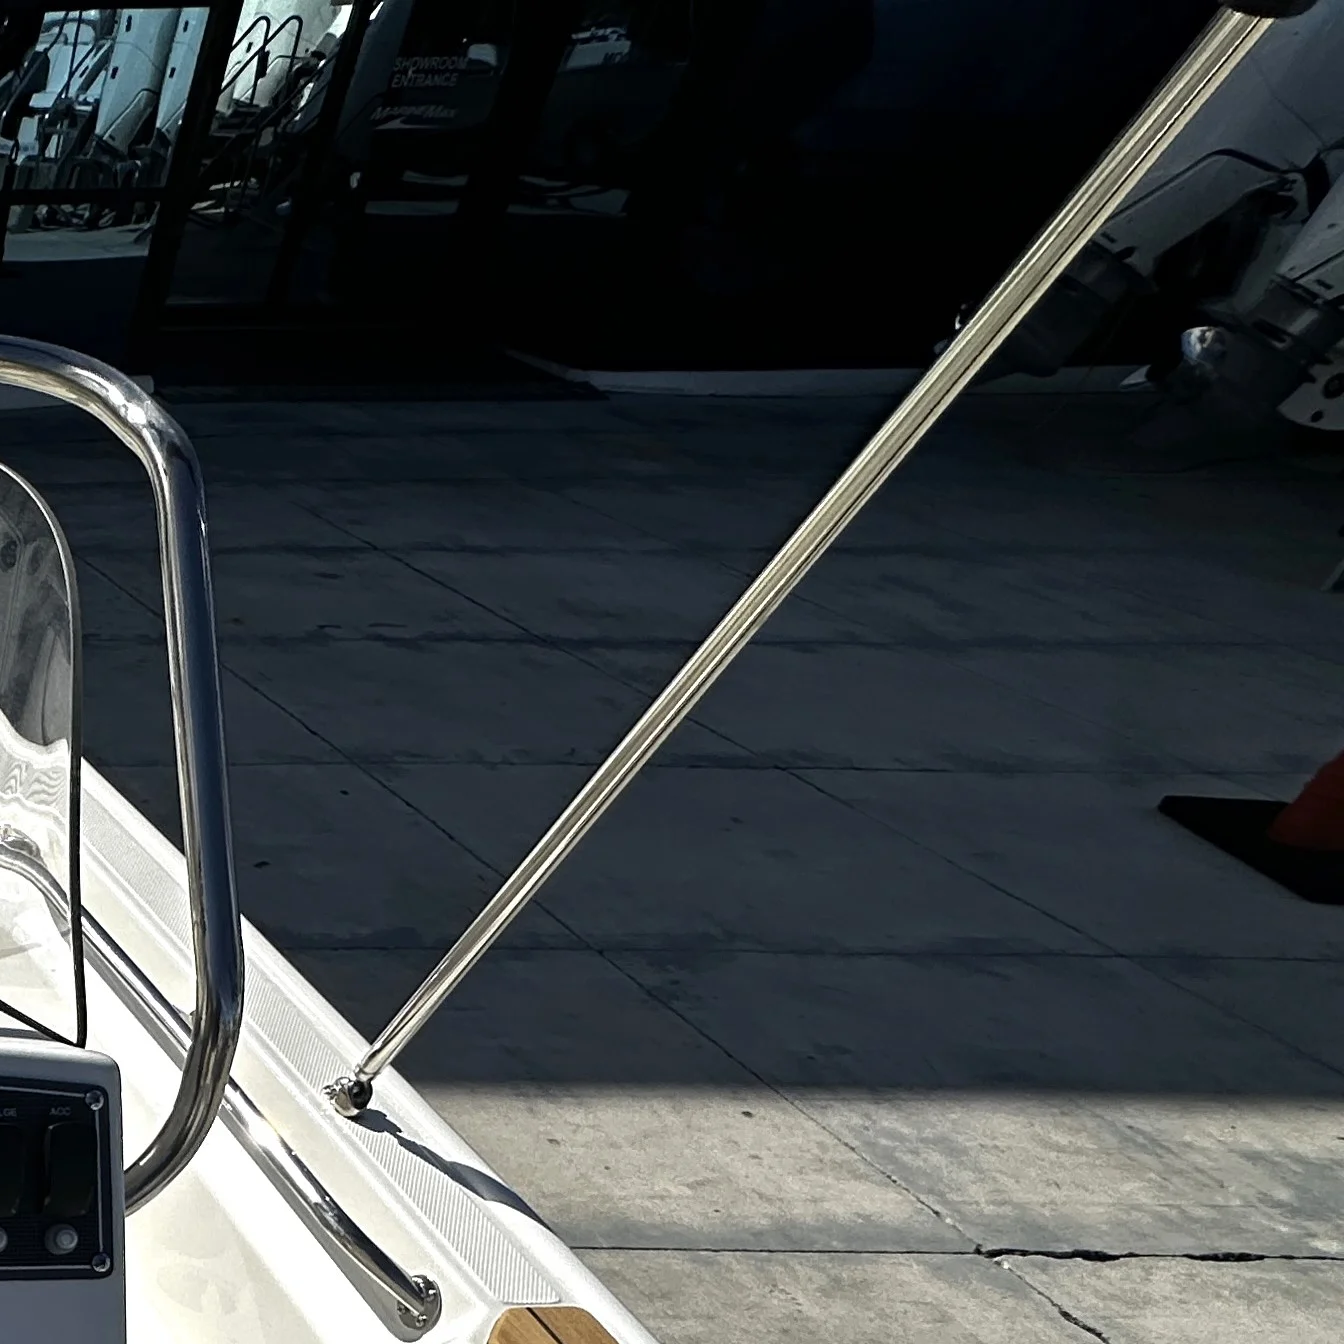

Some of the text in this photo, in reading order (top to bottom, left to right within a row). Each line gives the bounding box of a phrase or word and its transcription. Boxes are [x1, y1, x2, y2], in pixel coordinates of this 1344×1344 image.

[393, 56, 469, 71] SHOWROOM
[391, 73, 459, 88] ENTRANCE
[49, 1106, 71, 1116] ACC
